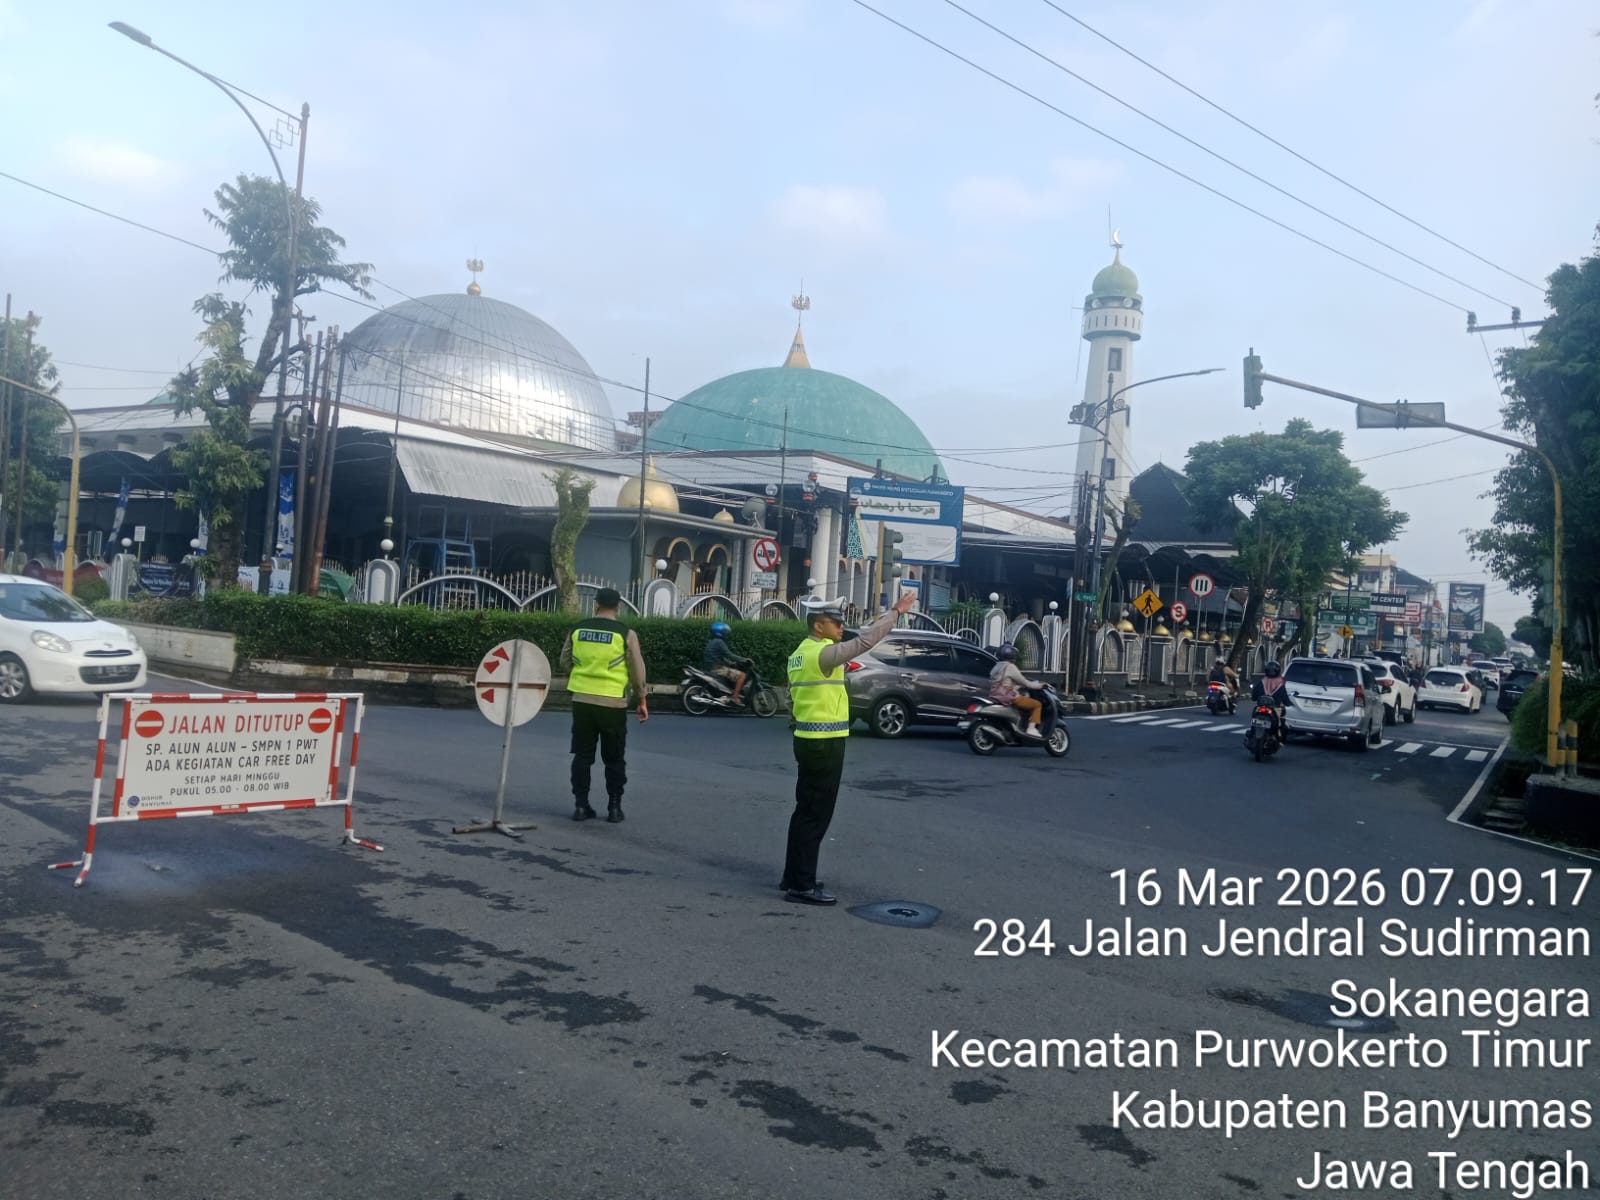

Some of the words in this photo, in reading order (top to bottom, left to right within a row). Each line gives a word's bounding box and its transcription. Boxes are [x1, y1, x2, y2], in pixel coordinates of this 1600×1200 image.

[579, 631, 612, 643] POLISI
[168, 715, 226, 735] JALAN
[235, 714, 304, 733] DITUTUP
[145, 743, 163, 756] SP.
[169, 742, 200, 755] ALUN
[206, 741, 236, 753] ALUN
[252, 740, 281, 752] SMPN
[286, 739, 291, 751] 1
[296, 739, 318, 750] PWT
[145, 760, 170, 772] ADA
[176, 757, 232, 770] KEGIATAN
[238, 756, 259, 768] CAR
[265, 755, 290, 767] FREE
[295, 753, 316, 765] DAY
[184, 775, 216, 785] SETIAP
[220, 774, 241, 783] HARI
[246, 772, 280, 782] MINGGU
[170, 787, 200, 796] PUKUL
[205, 785, 231, 794] 05.00
[243, 783, 269, 793] 08.00
[273, 782, 289, 791] WIB
